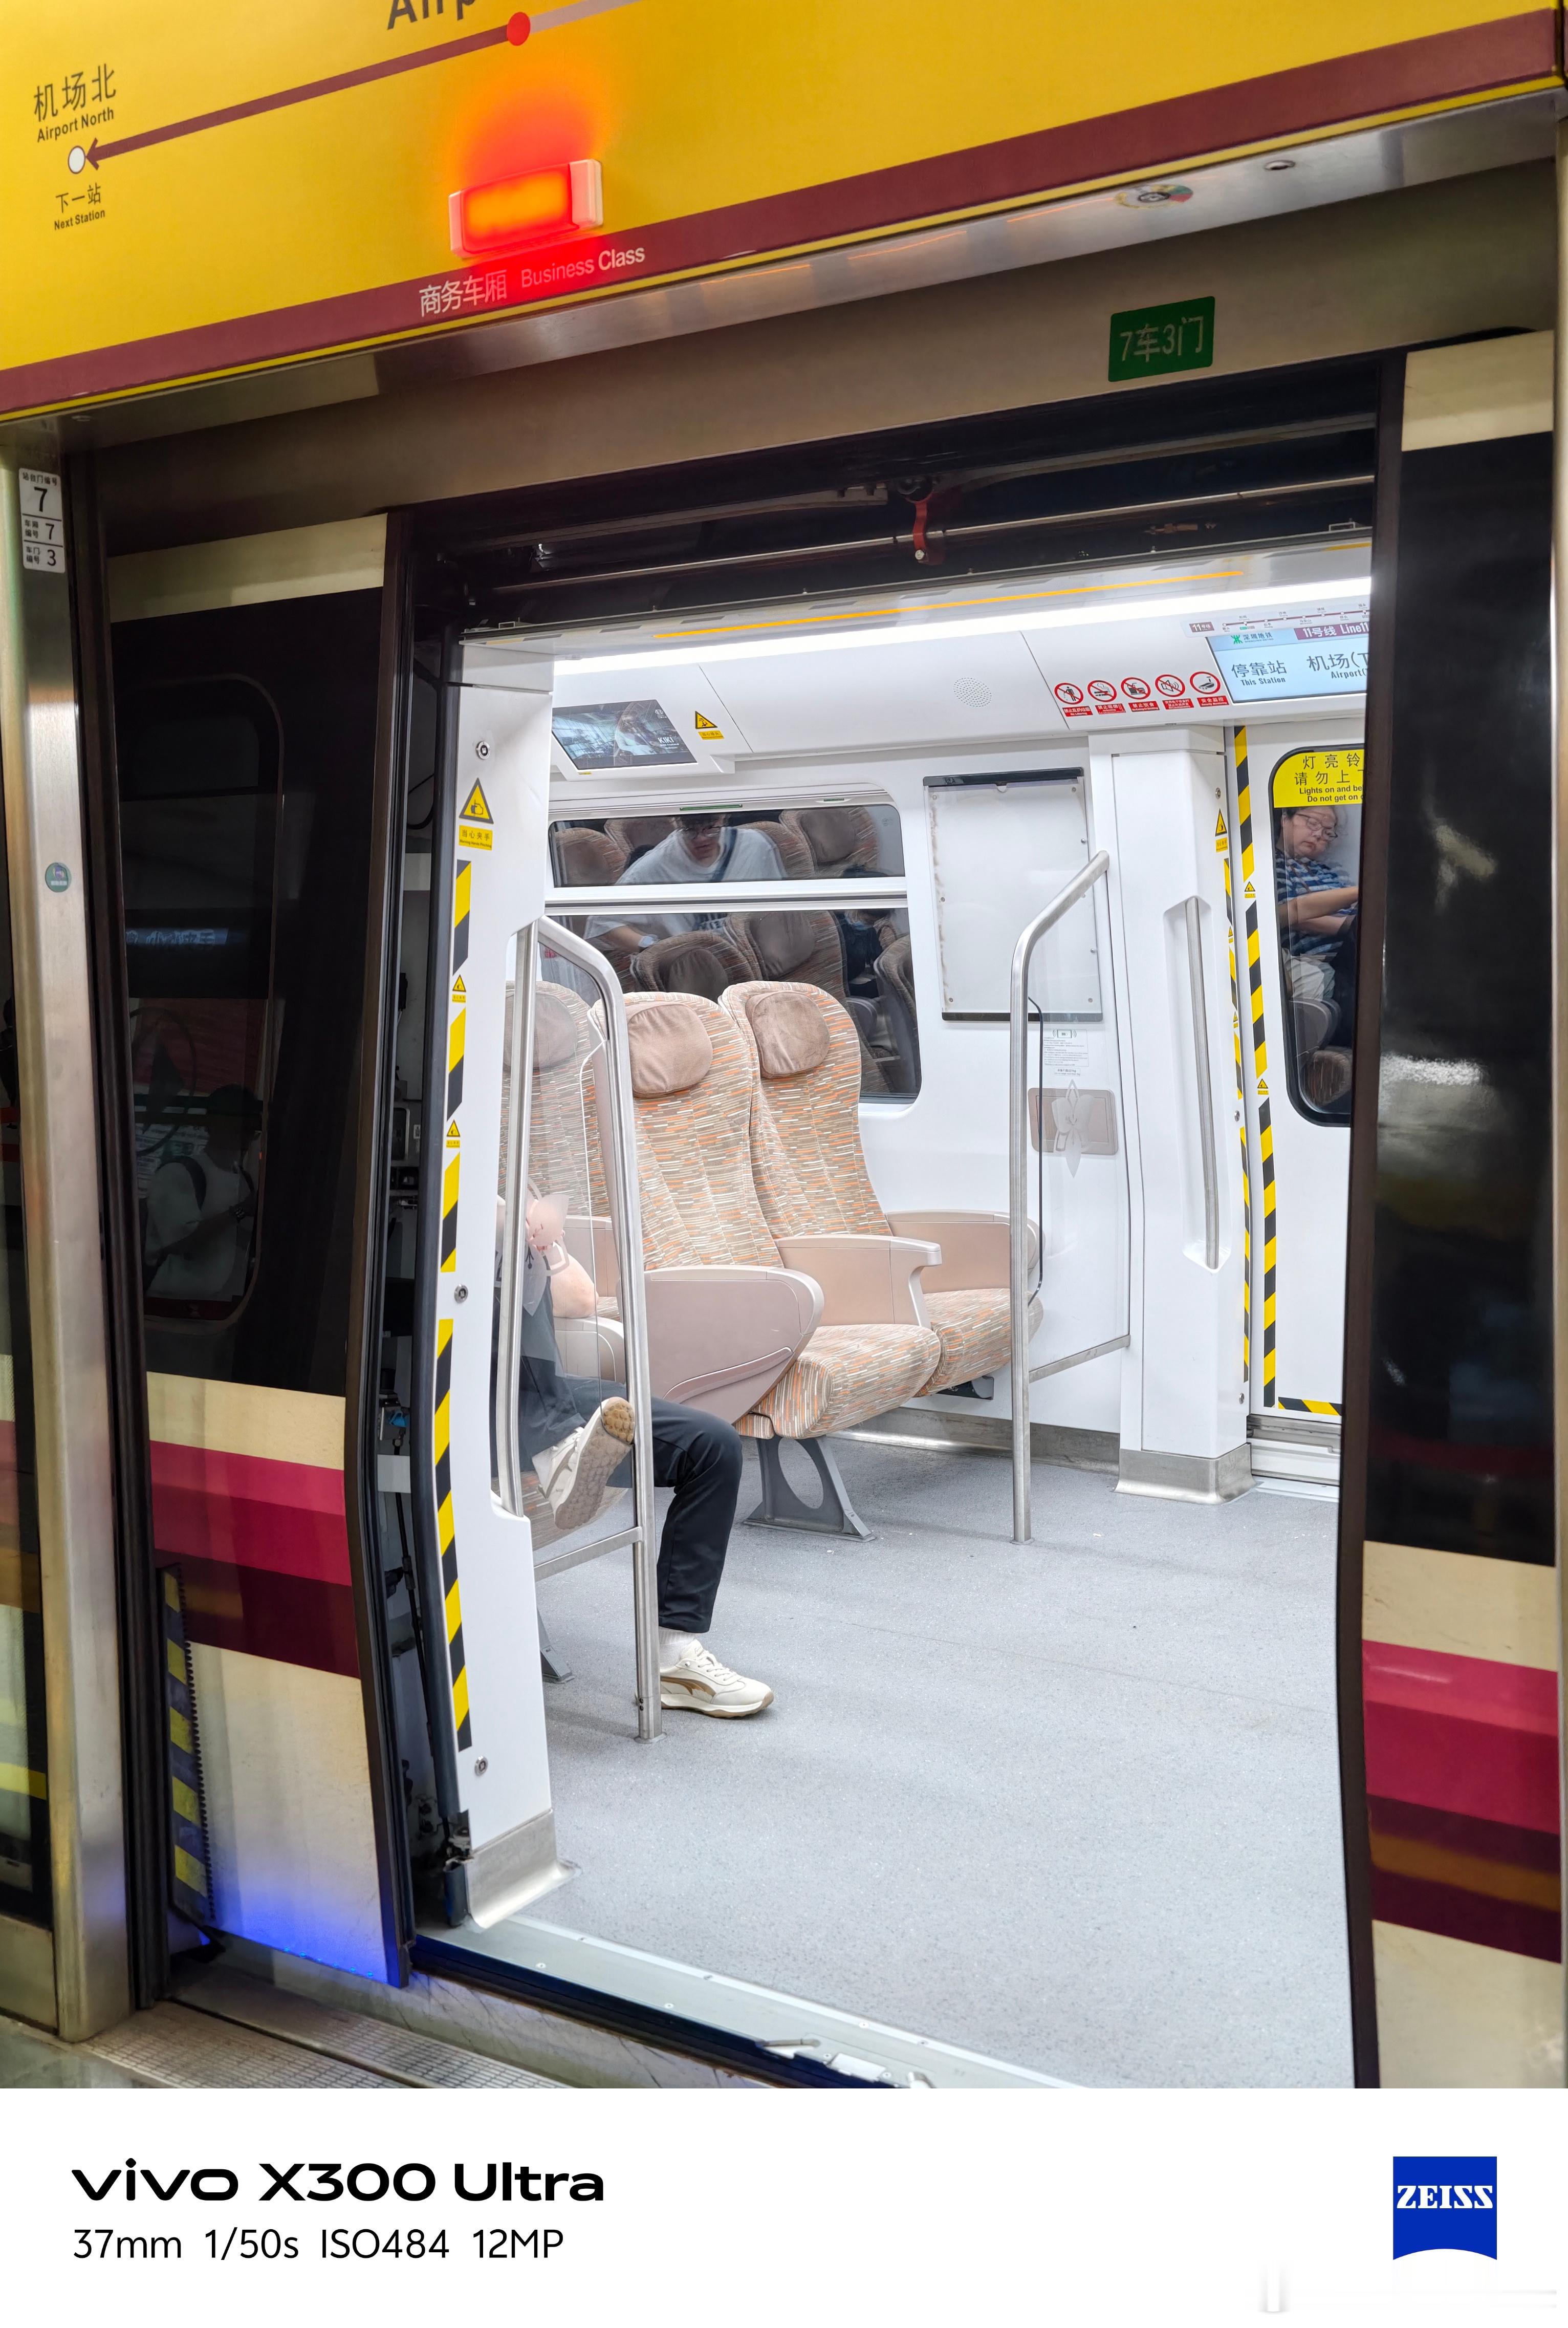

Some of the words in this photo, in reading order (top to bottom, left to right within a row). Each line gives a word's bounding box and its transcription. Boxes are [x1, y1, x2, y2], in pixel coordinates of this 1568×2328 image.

[34, 63, 116, 122] 机场北
[37, 118, 78, 143] Airport
[81, 106, 114, 128] North
[55, 182, 101, 213] 下一站
[54, 217, 73, 230] Next
[75, 210, 105, 225] Station
[419, 269, 508, 318] 商务车厢
[521, 258, 594, 288] Business
[598, 247, 645, 271] Class
[1119, 315, 1204, 362] 7车3门
[34, 486, 48, 512] 7
[46, 523, 54, 540] 7
[47, 549, 56, 566] 3
[1302, 626, 1337, 638] 11号线
[1340, 622, 1369, 634] Line11
[1231, 660, 1287, 678] 停靠站
[1259, 676, 1286, 684] Station
[1303, 752, 1360, 769] 灯亮铃
[1294, 770, 1364, 786] 请勿上
[1299, 786, 1322, 795] Lights
[462, 829, 490, 841] 当心夹手
